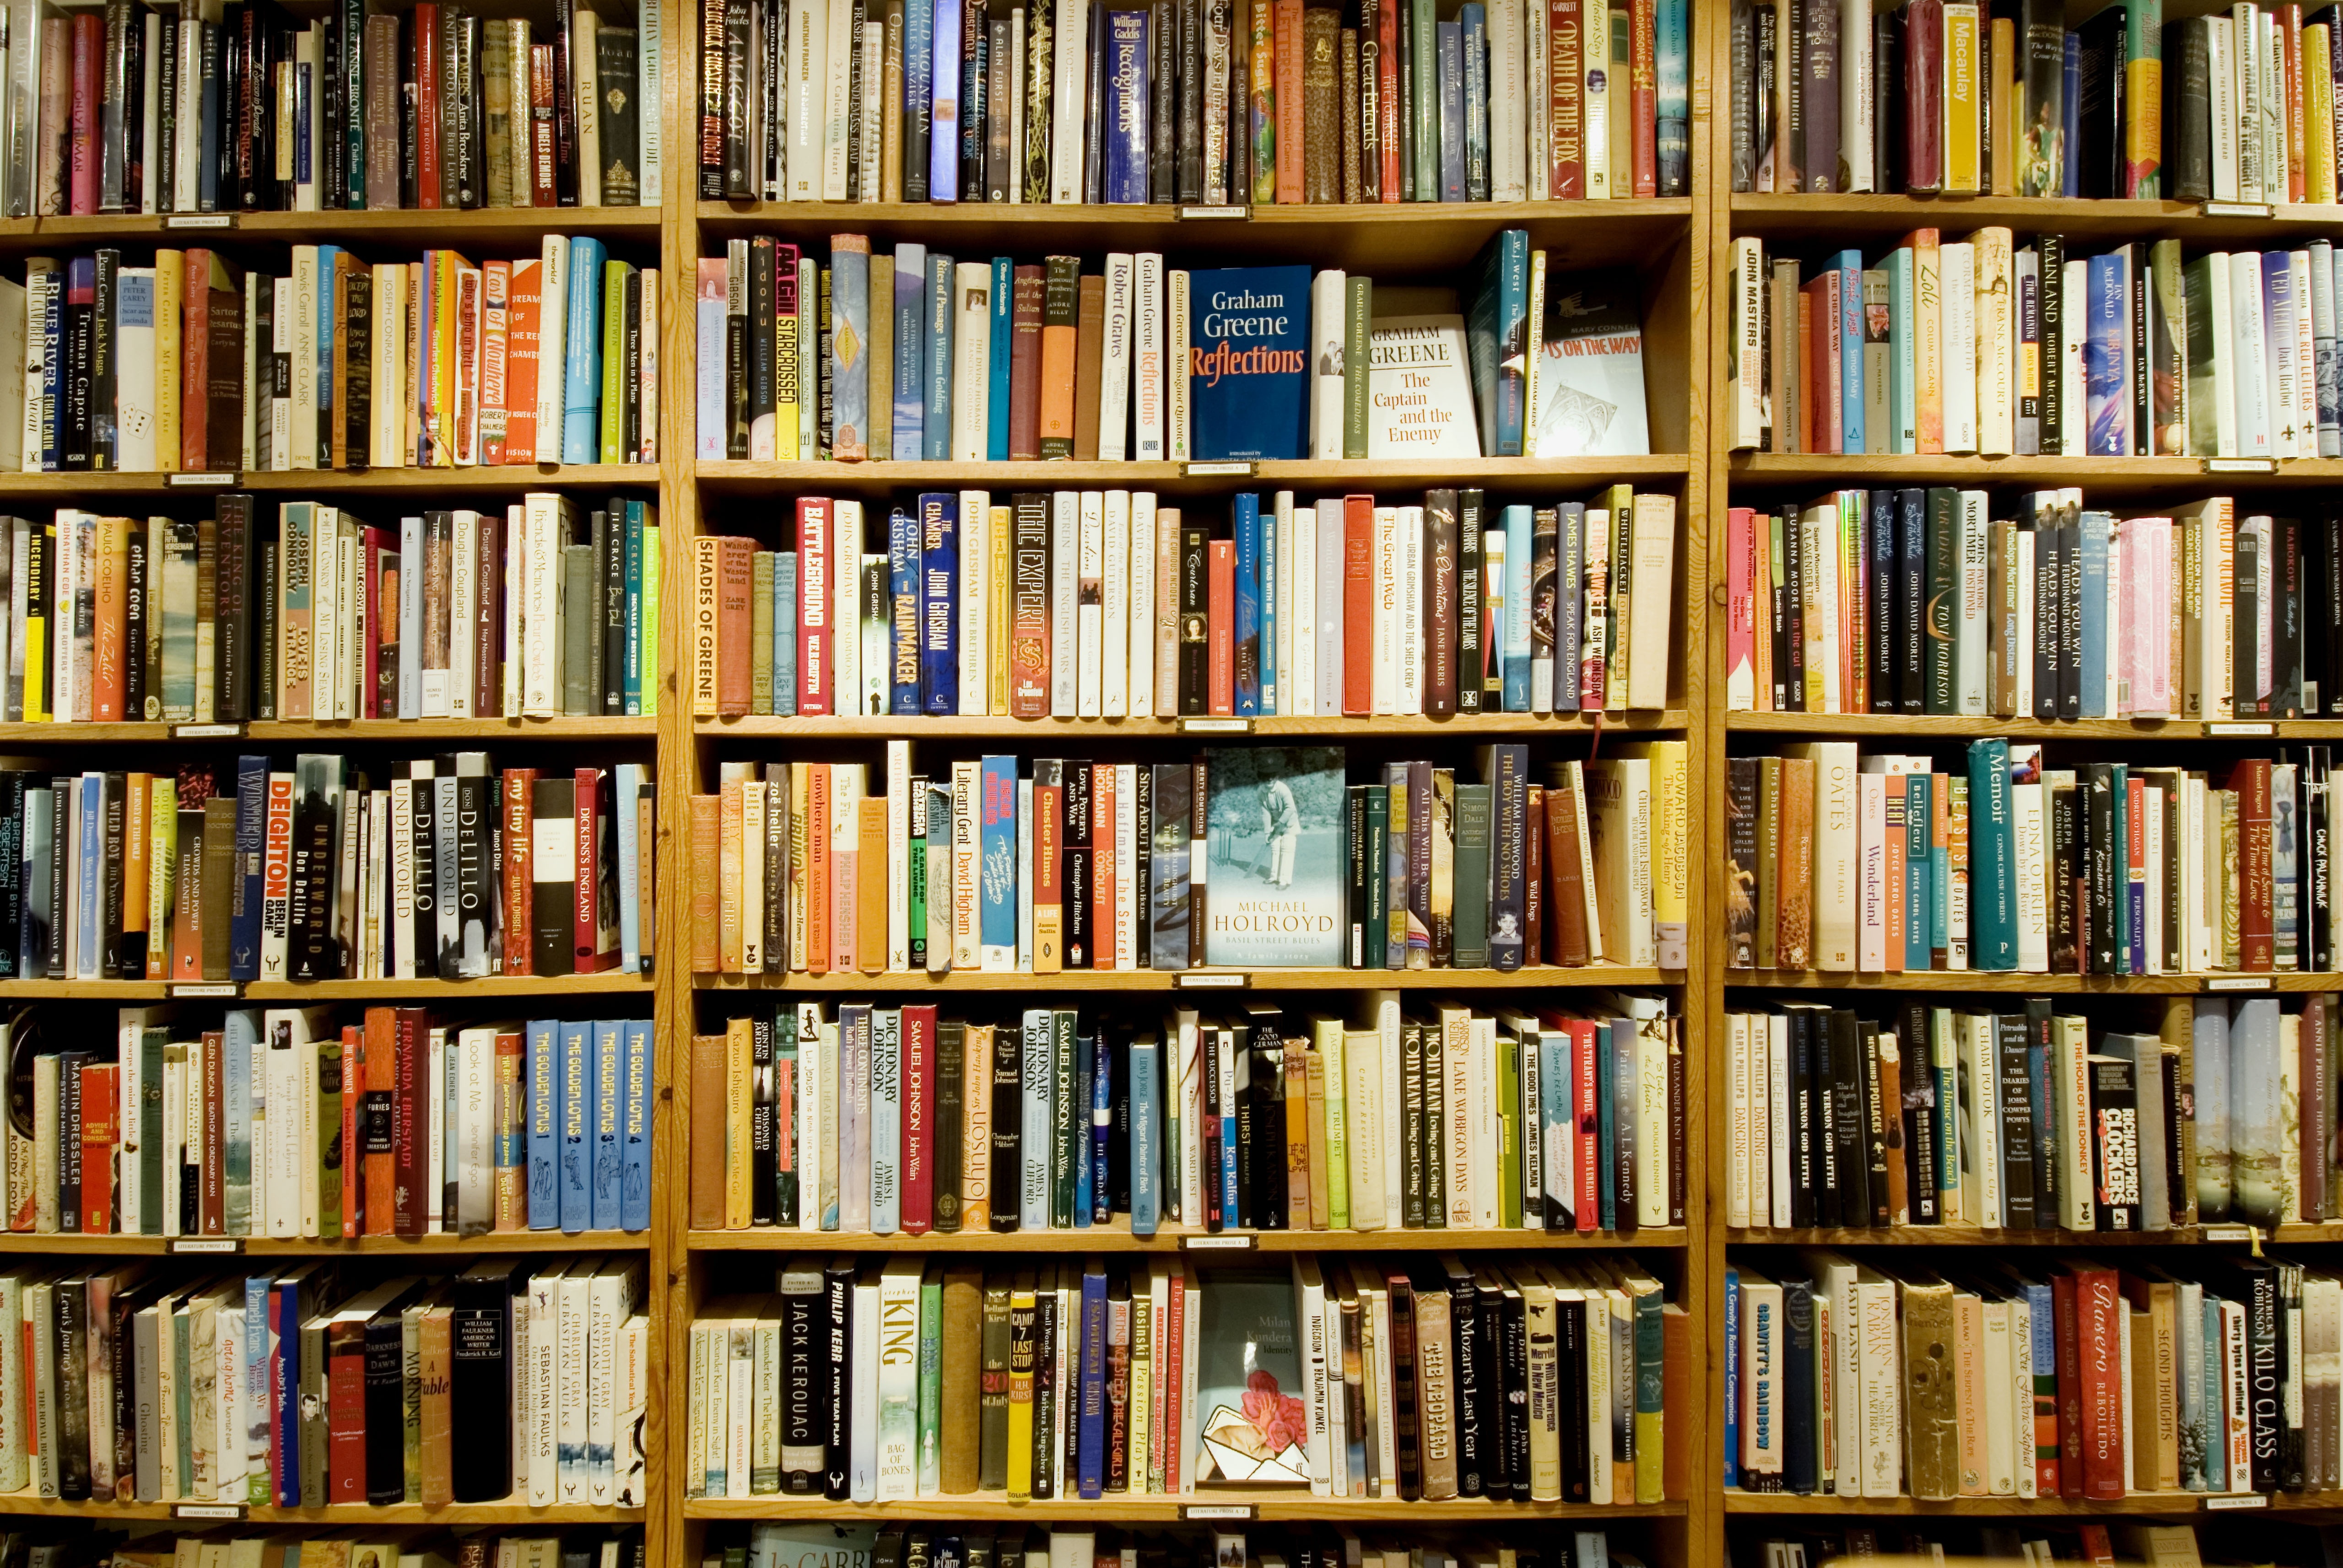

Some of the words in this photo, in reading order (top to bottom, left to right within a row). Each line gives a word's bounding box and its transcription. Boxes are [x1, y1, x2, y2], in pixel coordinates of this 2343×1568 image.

[163, 25, 173, 55] Lucky
[1113, 16, 1141, 27] William
[1114, 27, 1140, 40] Gaddis
[1552, 21, 1578, 80] DEATH
[1953, 22, 1970, 102] Macaulay
[582, 81, 593, 135] RUAN
[1113, 44, 1135, 132] Recognitions
[1553, 82, 1578, 101] OF
[537, 123, 550, 154] ANGELS
[1553, 103, 1579, 134] THE
[540, 156, 551, 189] DEMONS
[1554, 138, 1579, 165] FOX
[487, 270, 505, 301] East
[1113, 263, 1128, 311] Robert
[1746, 248, 1757, 283] JOHN
[2044, 239, 2057, 323] MAINLAND
[45, 282, 60, 329] BLUE
[487, 311, 505, 328] of
[1213, 290, 1283, 310] Graham
[1747, 286, 1758, 347] MASTERS
[78, 312, 91, 369] Truman
[1111, 312, 1127, 359] Graves
[1204, 313, 1289, 338] Greene
[1372, 326, 1440, 342] GRAHAM
[44, 333, 58, 387] RIVER
[486, 336, 505, 405] Nowhere
[777, 320, 796, 404] STARCROSSED
[1190, 340, 1304, 388] Reflections
[1369, 344, 1449, 364] GREENE
[2046, 332, 2055, 375] ROBERT
[1375, 393, 1427, 410] Captain
[1401, 373, 1430, 388] The
[75, 376, 88, 431] Capote
[1400, 410, 1426, 424] and
[1430, 409, 1452, 423] the
[1389, 428, 1441, 444] Enemy
[892, 507, 905, 573] GRISHAM
[907, 519, 918, 560] JOHN
[926, 502, 942, 550] CHAMBER
[941, 520, 952, 534] THE
[1018, 501, 1046, 545] THE
[30, 534, 41, 601] INCENDIARY
[287, 522, 297, 594] CONNOLLY
[299, 530, 308, 587] JOSEPH
[804, 507, 824, 627] BATTLEGROUND
[1620, 509, 1629, 594] WHISTLEJACKET
[700, 541, 713, 606] SHADES
[928, 568, 949, 597] JOHN
[1018, 550, 1045, 632] EXPERT
[699, 614, 713, 633] OF
[929, 601, 950, 651] GRISHAM
[1566, 602, 1575, 631] SPEAK
[1938, 605, 1949, 636] TONI
[896, 594, 916, 684] RAINMAKER
[699, 640, 712, 699] GREENE
[1567, 654, 1575, 700] ENGLAND
[1936, 641, 1949, 706] MORRISON
[512, 780, 524, 800] my
[956, 769, 972, 817] Literary
[1990, 753, 2006, 824] Memoir
[267, 781, 292, 898] DEIGHTON
[509, 805, 525, 833] tiny
[770, 807, 779, 848] heller
[958, 818, 972, 846] Gent
[1042, 792, 1053, 845] Chester
[1953, 787, 1967, 862] BEASTS
[297, 851, 308, 873] Don
[395, 786, 411, 919] UNDERWORLD
[442, 783, 455, 916] UNDERWORLD
[513, 838, 529, 863] life
[958, 852, 972, 884] David
[1043, 846, 1052, 888] Himes
[294, 880, 307, 925] DeLillo
[580, 868, 590, 923] ENGLAND
[1239, 901, 1308, 912] MICHAEL
[1868, 845, 1880, 927] Wonderland
[265, 900, 274, 931] GAME
[275, 900, 286, 938] BERLIN
[956, 889, 973, 935] Higham
[1215, 916, 1333, 932] HOLROYD
[537, 1033, 549, 1053] THE
[873, 1026, 884, 1093] JOHNSON
[885, 1016, 896, 1103] DICTIONARY
[911, 1020, 922, 1070] SAMUEL
[1527, 1053, 1535, 1070] THE
[71, 1061, 81, 1110] MARTIN
[536, 1055, 550, 1097] GOLDEN
[1453, 1061, 1466, 1094] LAKE
[1527, 1072, 1536, 1093] GOOD
[536, 1099, 550, 1132] LOTUS
[909, 1069, 922, 1131] JOHNSON
[1527, 1095, 1536, 1115] TIMES
[71, 1114, 81, 1185] DRESSLER
[910, 1135, 920, 1156] John
[1454, 1099, 1468, 1159] WOBEGON
[1528, 1122, 1538, 1150] JAMES
[2122, 1108, 2137, 1167] RICHARD
[909, 1157, 920, 1181] Wain
[1455, 1163, 1468, 1192] DAYS
[1529, 1154, 1538, 1188] KELMAN
[2105, 1108, 2125, 1205] CLOCKERS
[2124, 1167, 2138, 1205] PRICE
[793, 1302, 807, 1347] JACK
[831, 1282, 843, 1324] PHILIP
[1012, 1313, 1034, 1326] CAMP
[2253, 1278, 2265, 1338] ROBINSON
[831, 1329, 843, 1363] KERR
[881, 1299, 915, 1366] KING
[1013, 1341, 1033, 1354] LAST
[1461, 1318, 1475, 1385] Mozart's
[1757, 1303, 1770, 1376] GRAVITY'S
[540, 1345, 550, 1409] SEBASTIAN
[1012, 1354, 1033, 1368] STOP
[1424, 1342, 1444, 1378] THE
[2254, 1343, 2275, 1392] KILO
[793, 1354, 807, 1438] KEROUAC
[1462, 1388, 1477, 1422] Last
[1757, 1381, 1770, 1450] RAINBOW
[540, 1412, 550, 1457] FAULKS
[1425, 1381, 1448, 1460] LEOPARD
[1465, 1423, 1479, 1460] Year
[2254, 1398, 2276, 1459] CLASS
[881, 1465, 910, 1476] BONES
[887, 1444, 905, 1454] BAG
[890, 1455, 902, 1464] OF
